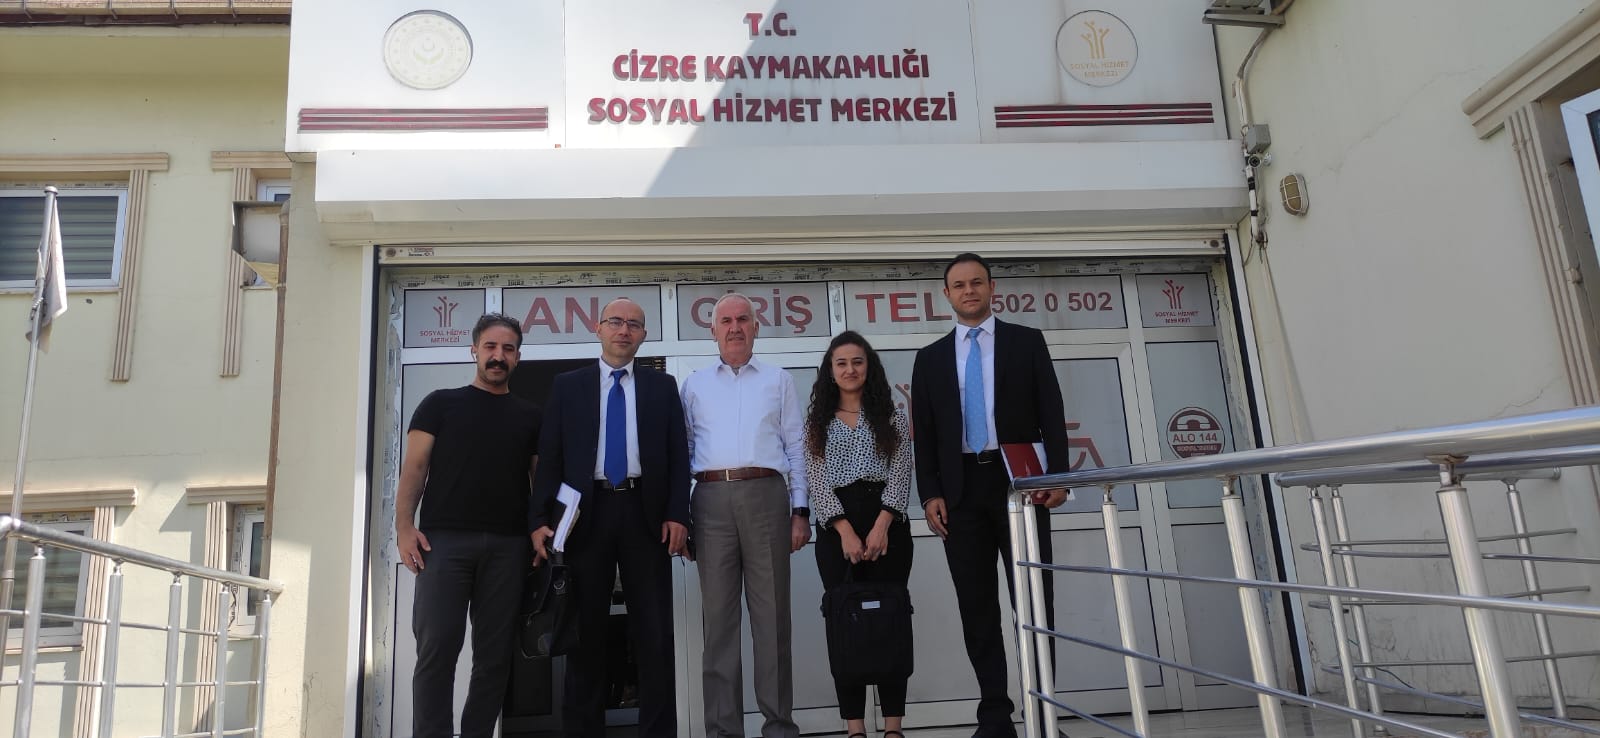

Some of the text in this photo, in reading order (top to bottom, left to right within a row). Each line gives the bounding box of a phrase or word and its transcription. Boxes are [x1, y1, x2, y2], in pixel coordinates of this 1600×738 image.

[743, 12, 797, 39] T.C.
[612, 48, 930, 81] CİZRE KAYMAKAMLIĞI
[587, 91, 958, 125] SOSYAL HİZMET MERKEZİ
[521, 288, 813, 334] AN GRİŞ
[991, 293, 1037, 314] 502
[1044, 293, 1060, 313] 0
[1068, 292, 1114, 312] 502
[1173, 432, 1218, 443] ALO 144
